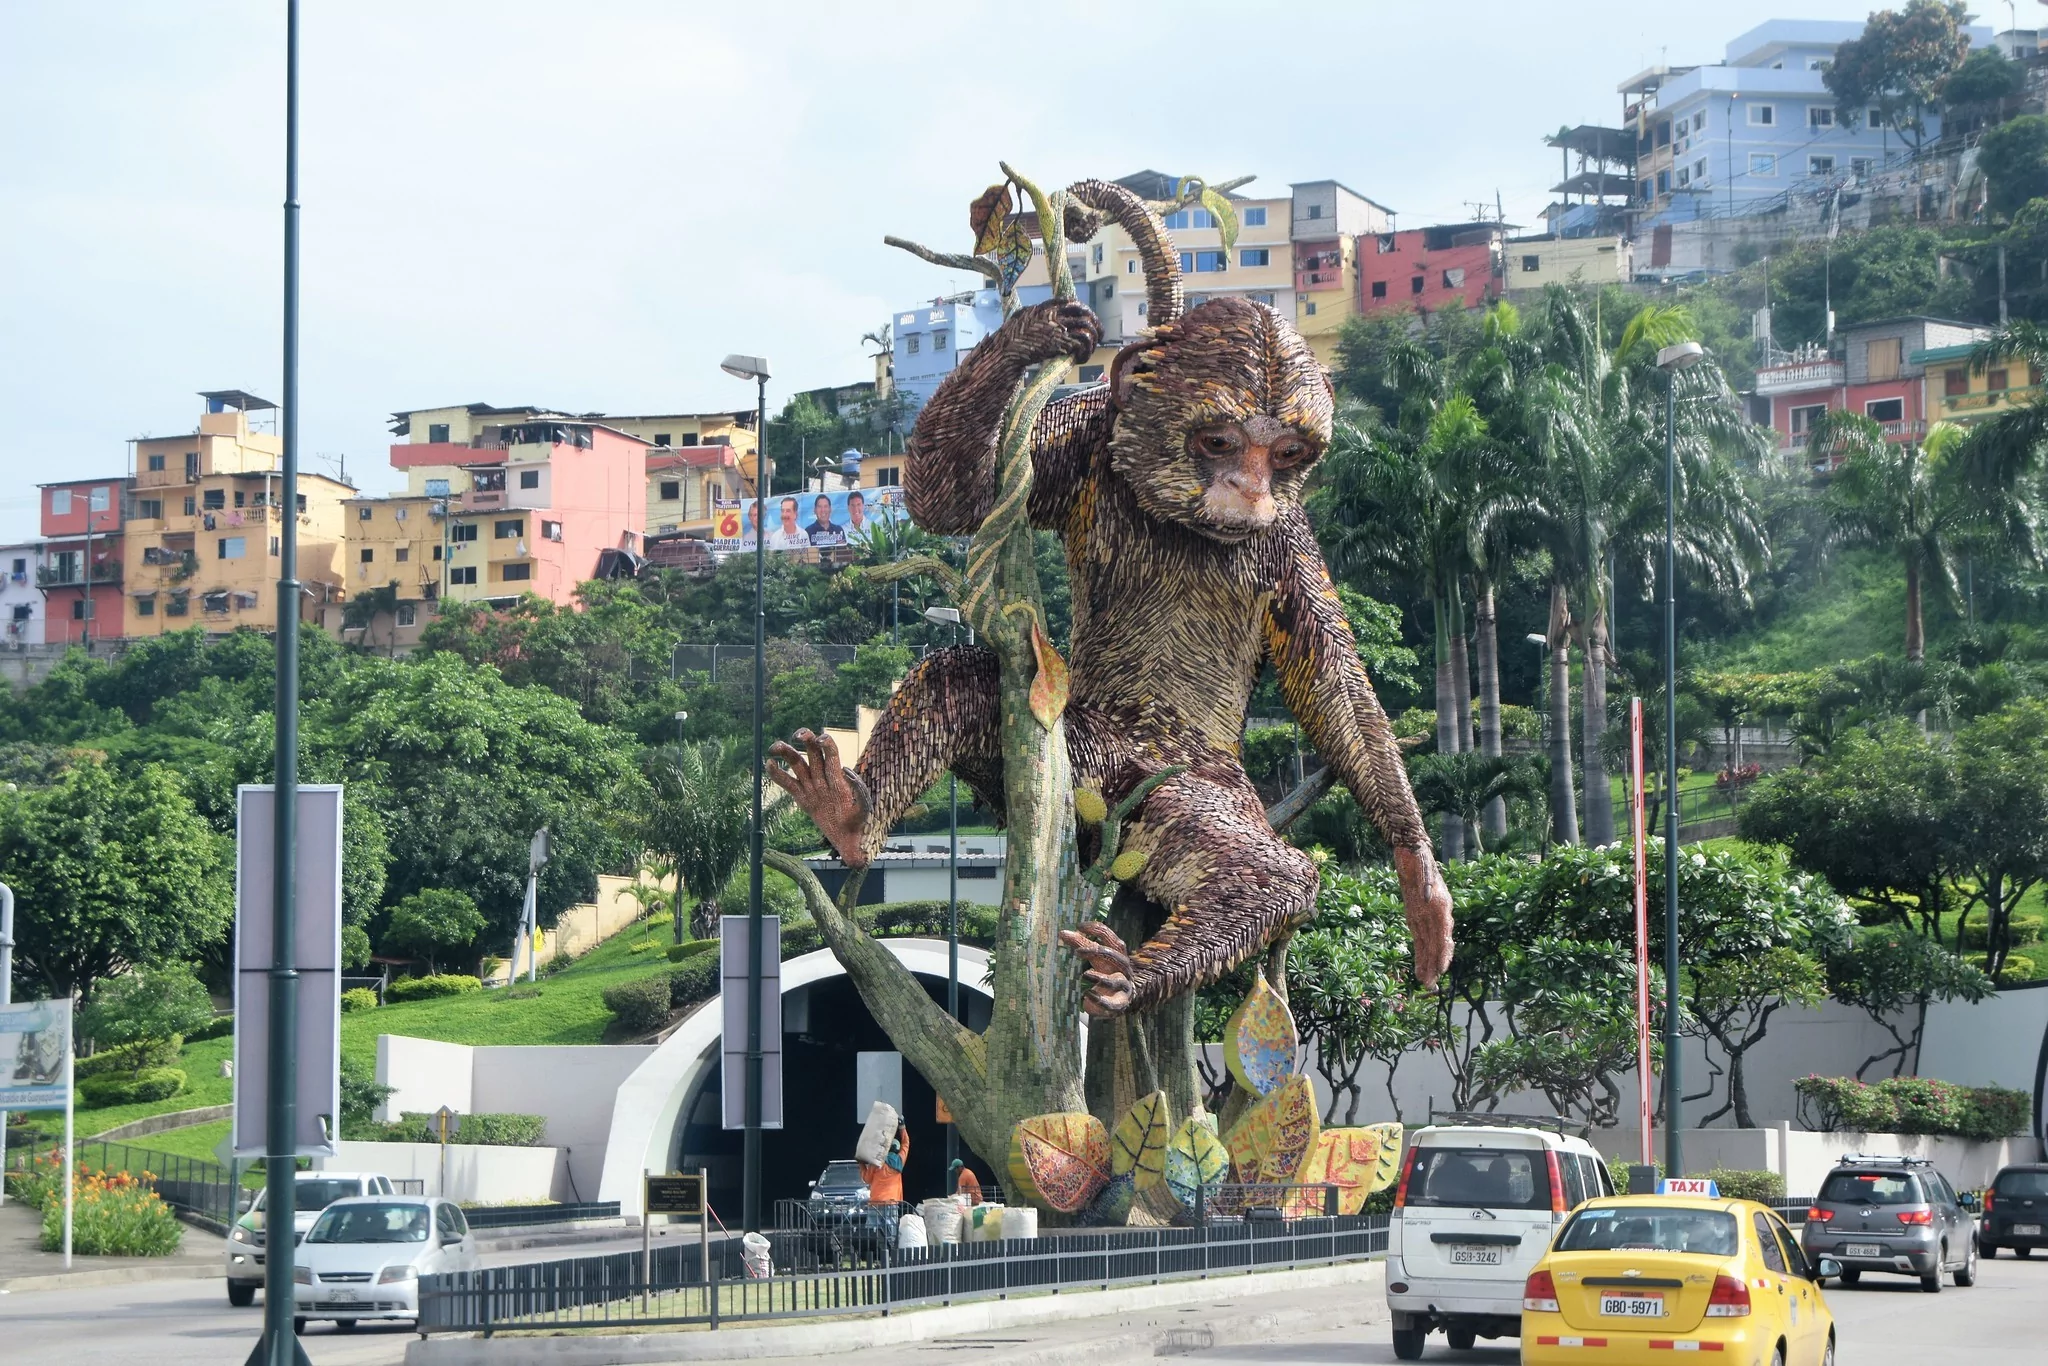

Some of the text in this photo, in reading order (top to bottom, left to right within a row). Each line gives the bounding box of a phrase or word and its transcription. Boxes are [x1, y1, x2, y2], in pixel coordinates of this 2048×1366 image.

[720, 513, 739, 537] 6
[1670, 1181, 1705, 1192] TAXI
[1455, 1251, 1497, 1263] GSB-3242
